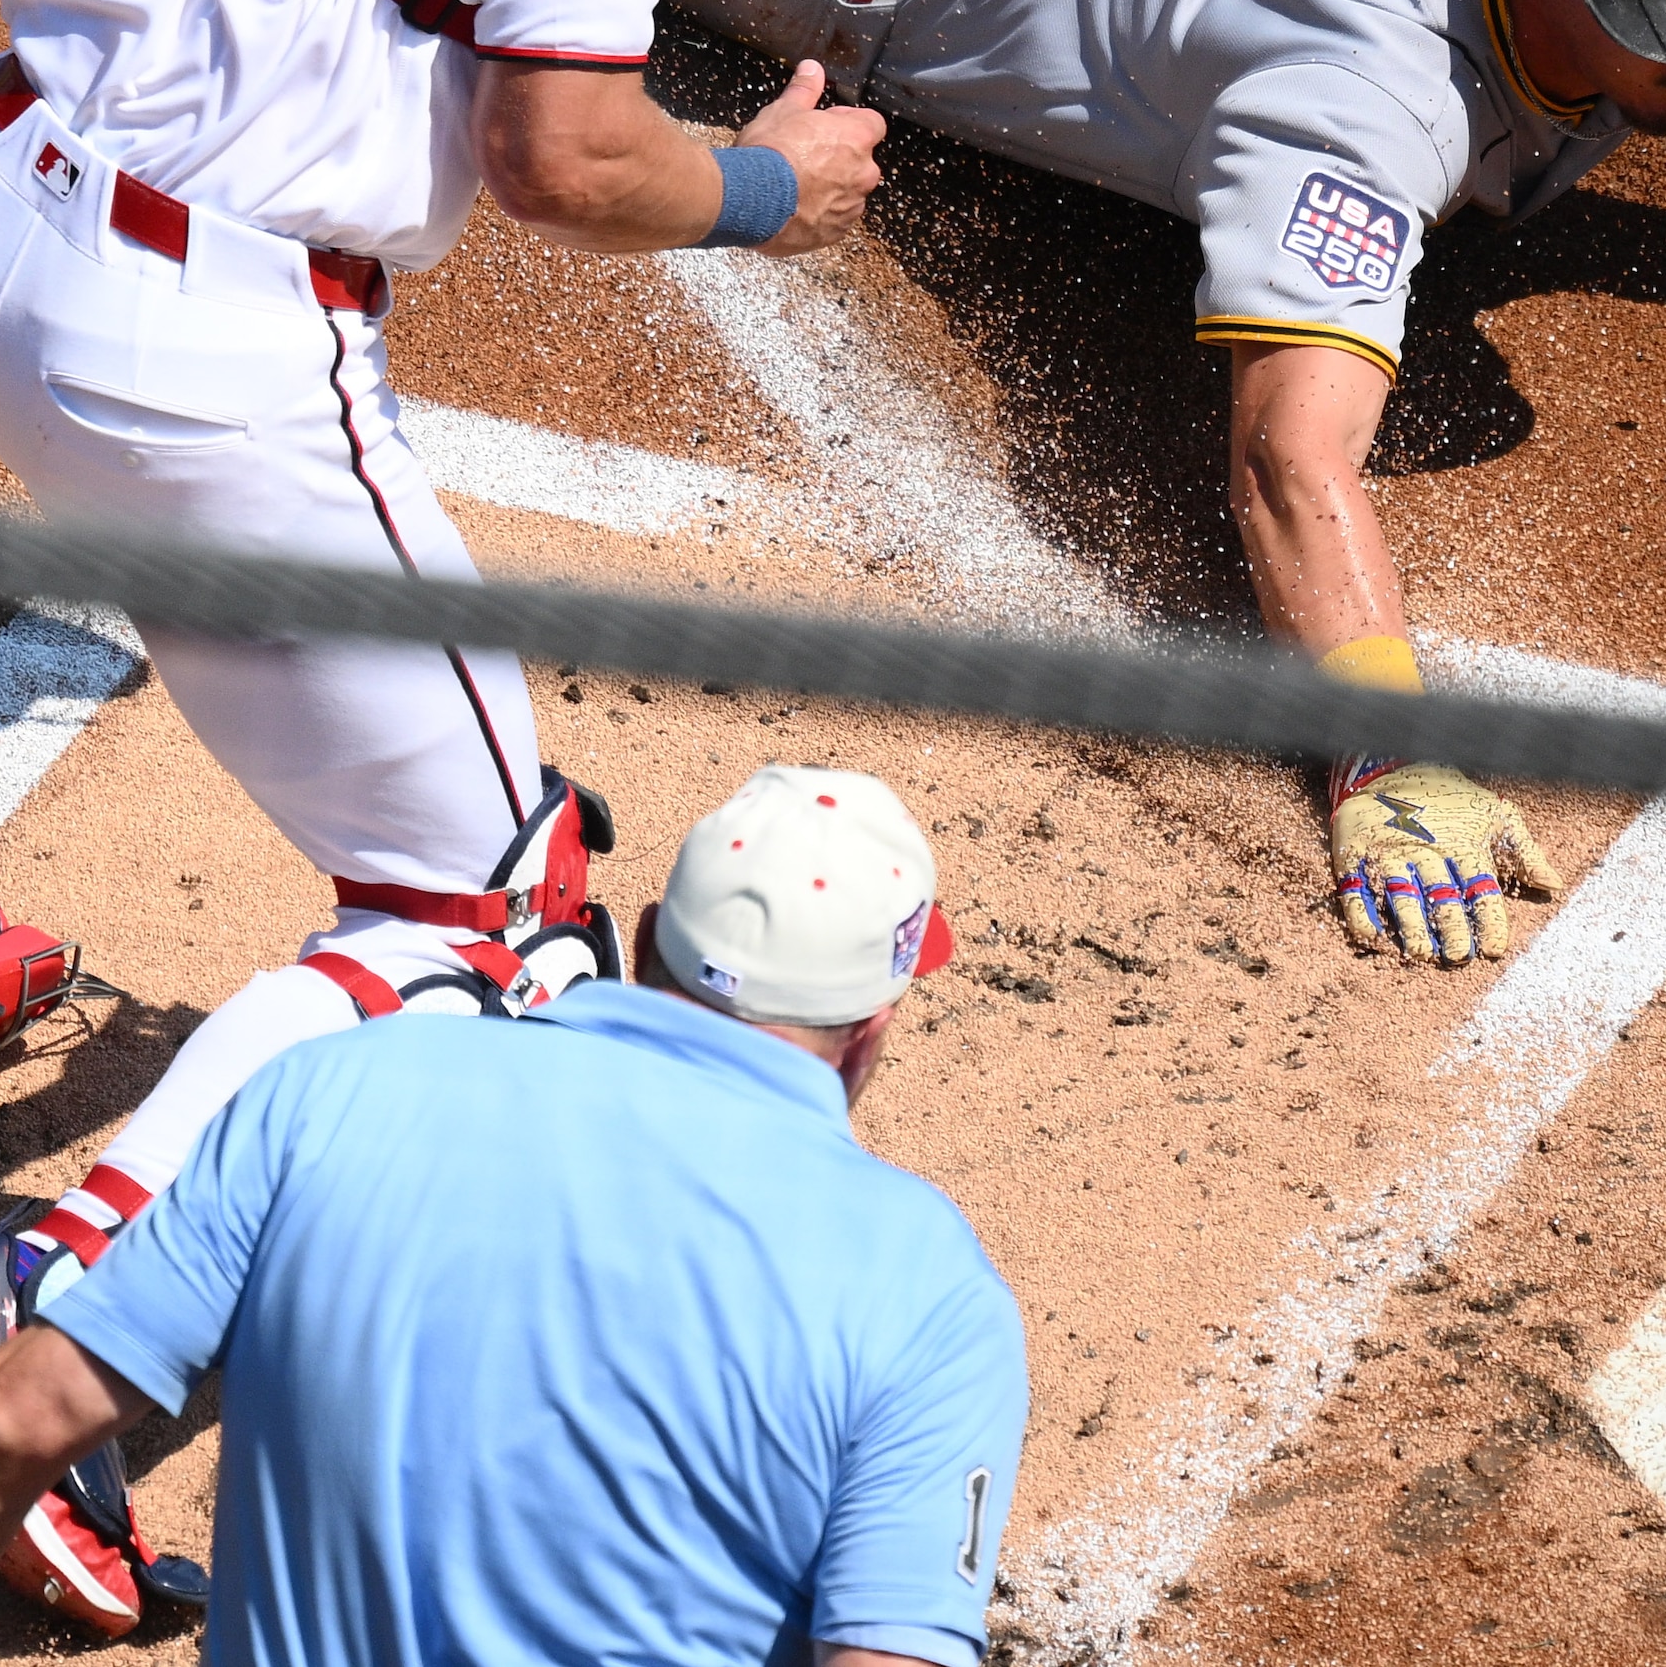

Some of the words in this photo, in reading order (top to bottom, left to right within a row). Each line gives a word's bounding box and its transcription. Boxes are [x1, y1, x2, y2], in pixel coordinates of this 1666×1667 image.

[1307, 181, 1398, 248] USA
[1286, 222, 1391, 290] 250
[956, 1465, 993, 1586] 1
